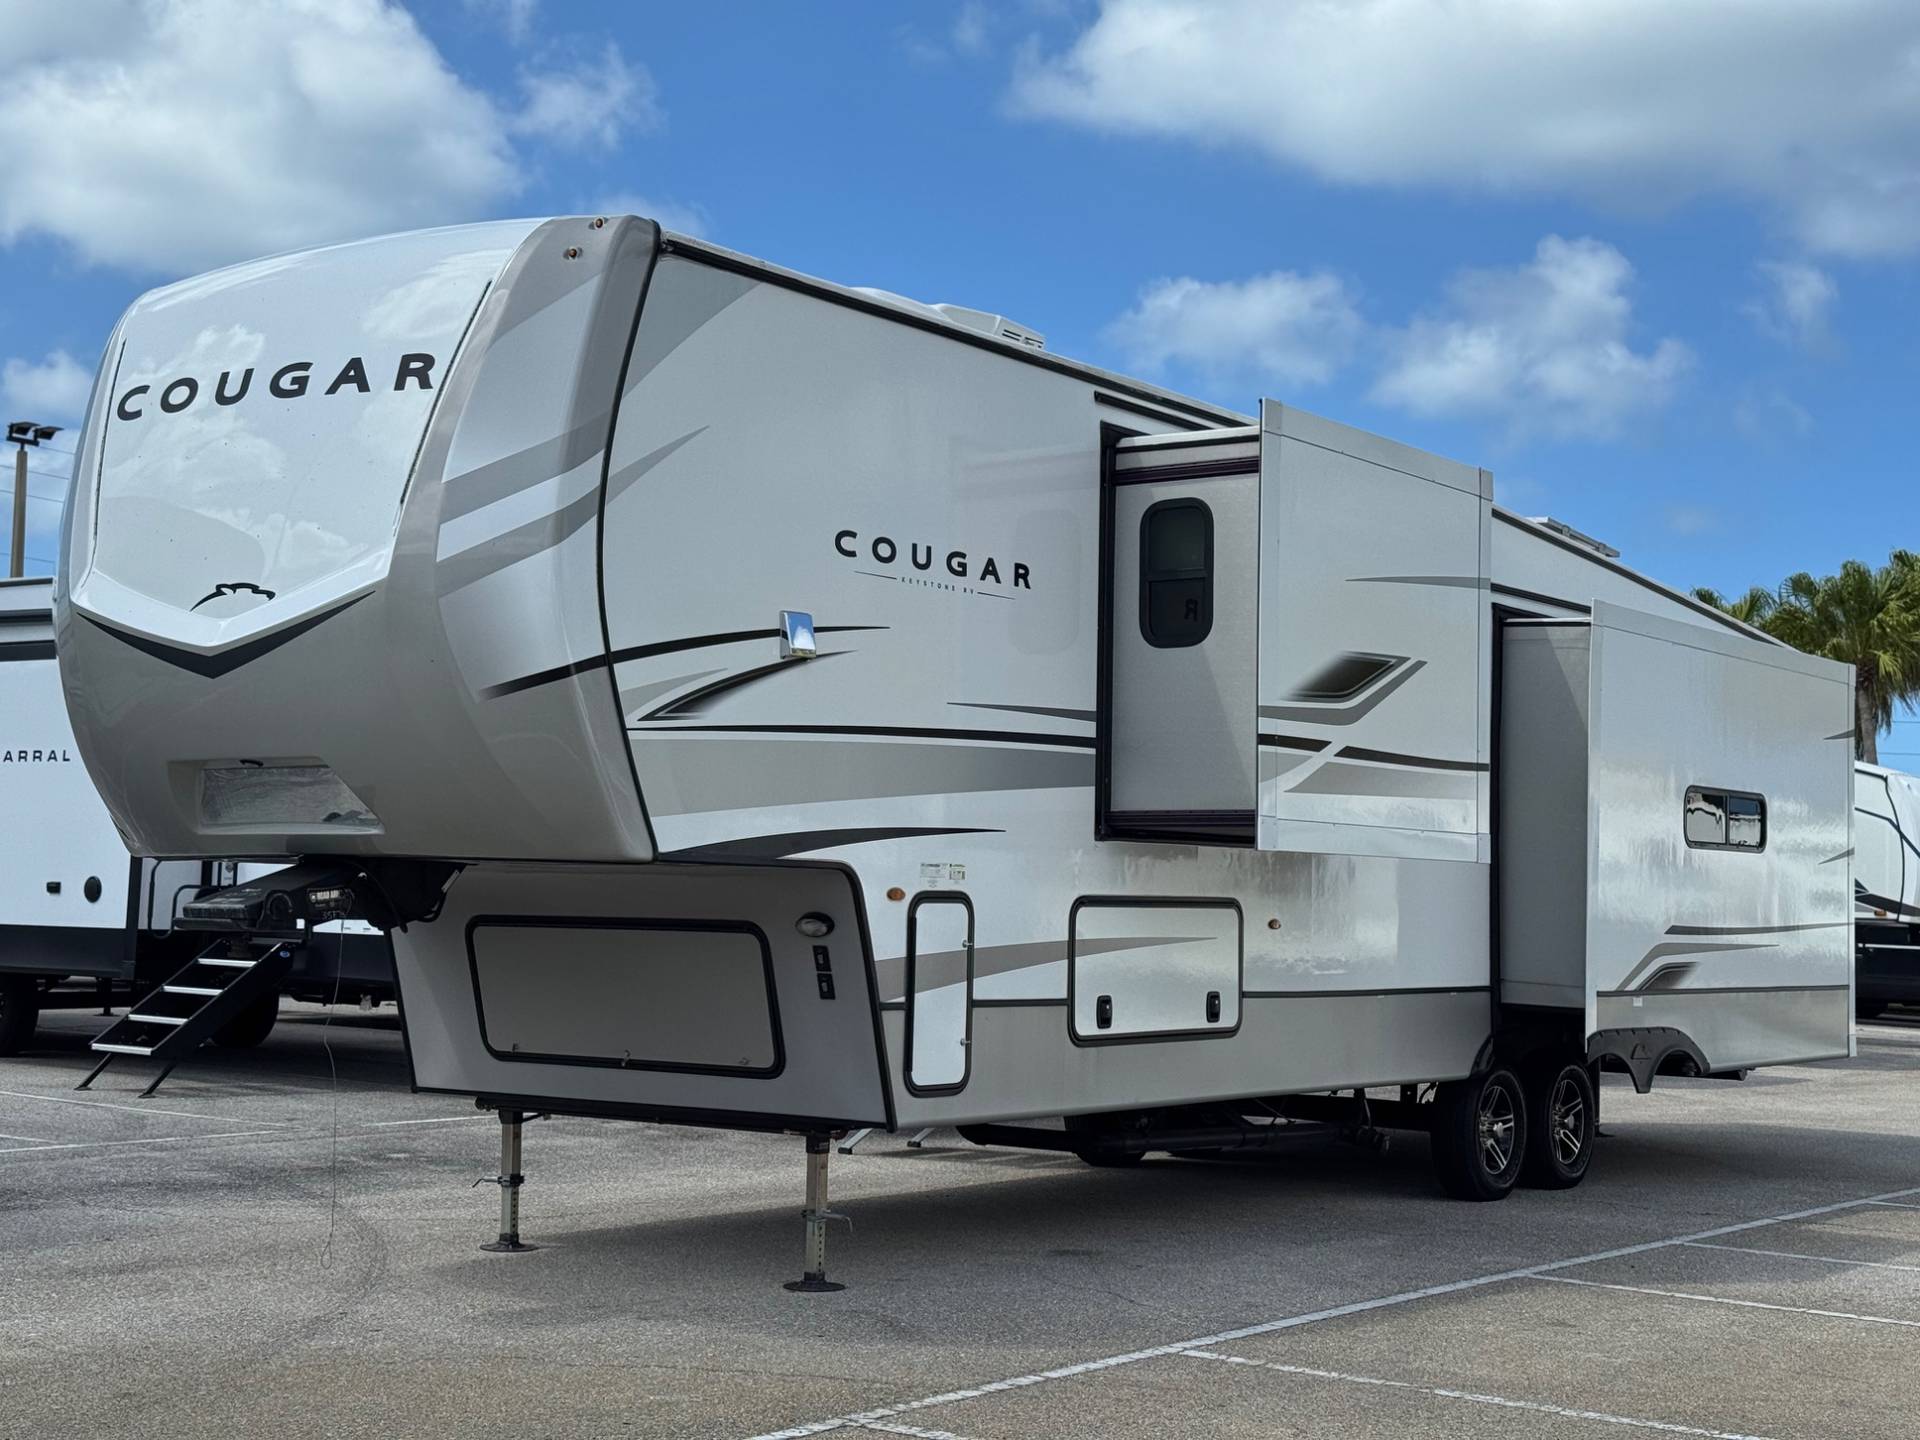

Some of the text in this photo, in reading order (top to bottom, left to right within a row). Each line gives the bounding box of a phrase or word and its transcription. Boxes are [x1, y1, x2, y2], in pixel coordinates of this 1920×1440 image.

[117, 352, 435, 421] COUGAR
[834, 529, 1031, 589] COUGAR
[901, 576, 956, 592] KEYSTONE
[3, 749, 71, 762] ARRAL
